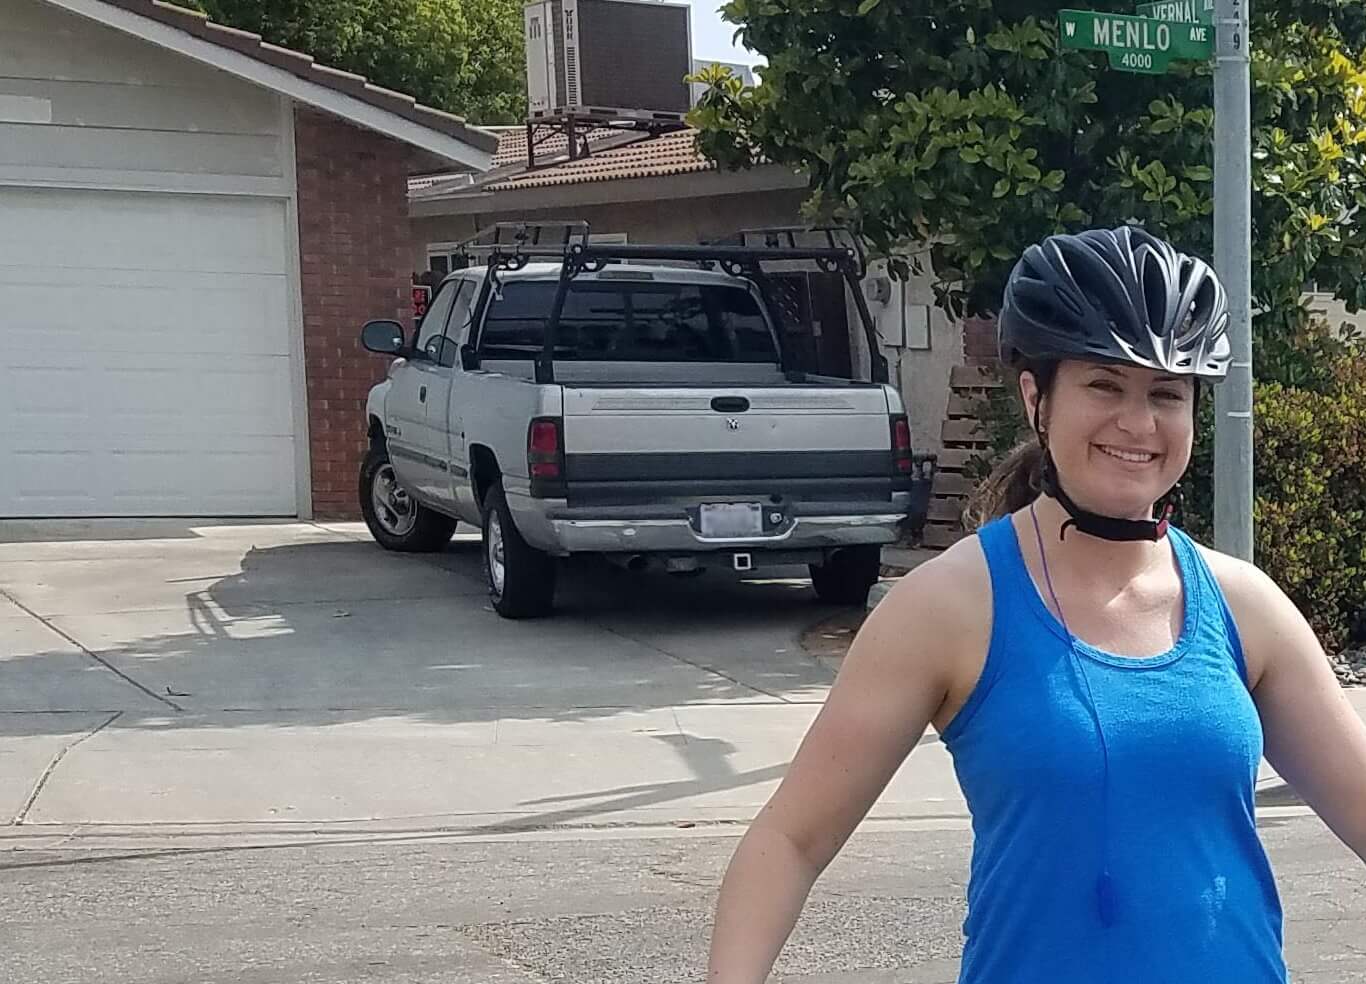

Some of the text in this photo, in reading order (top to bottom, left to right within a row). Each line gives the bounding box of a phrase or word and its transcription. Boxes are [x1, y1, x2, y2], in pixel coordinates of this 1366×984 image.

[1153, 0, 1199, 23] VERNAL
[1065, 18, 1207, 50] W MENLO AVE
[1121, 52, 1152, 69] 4000
